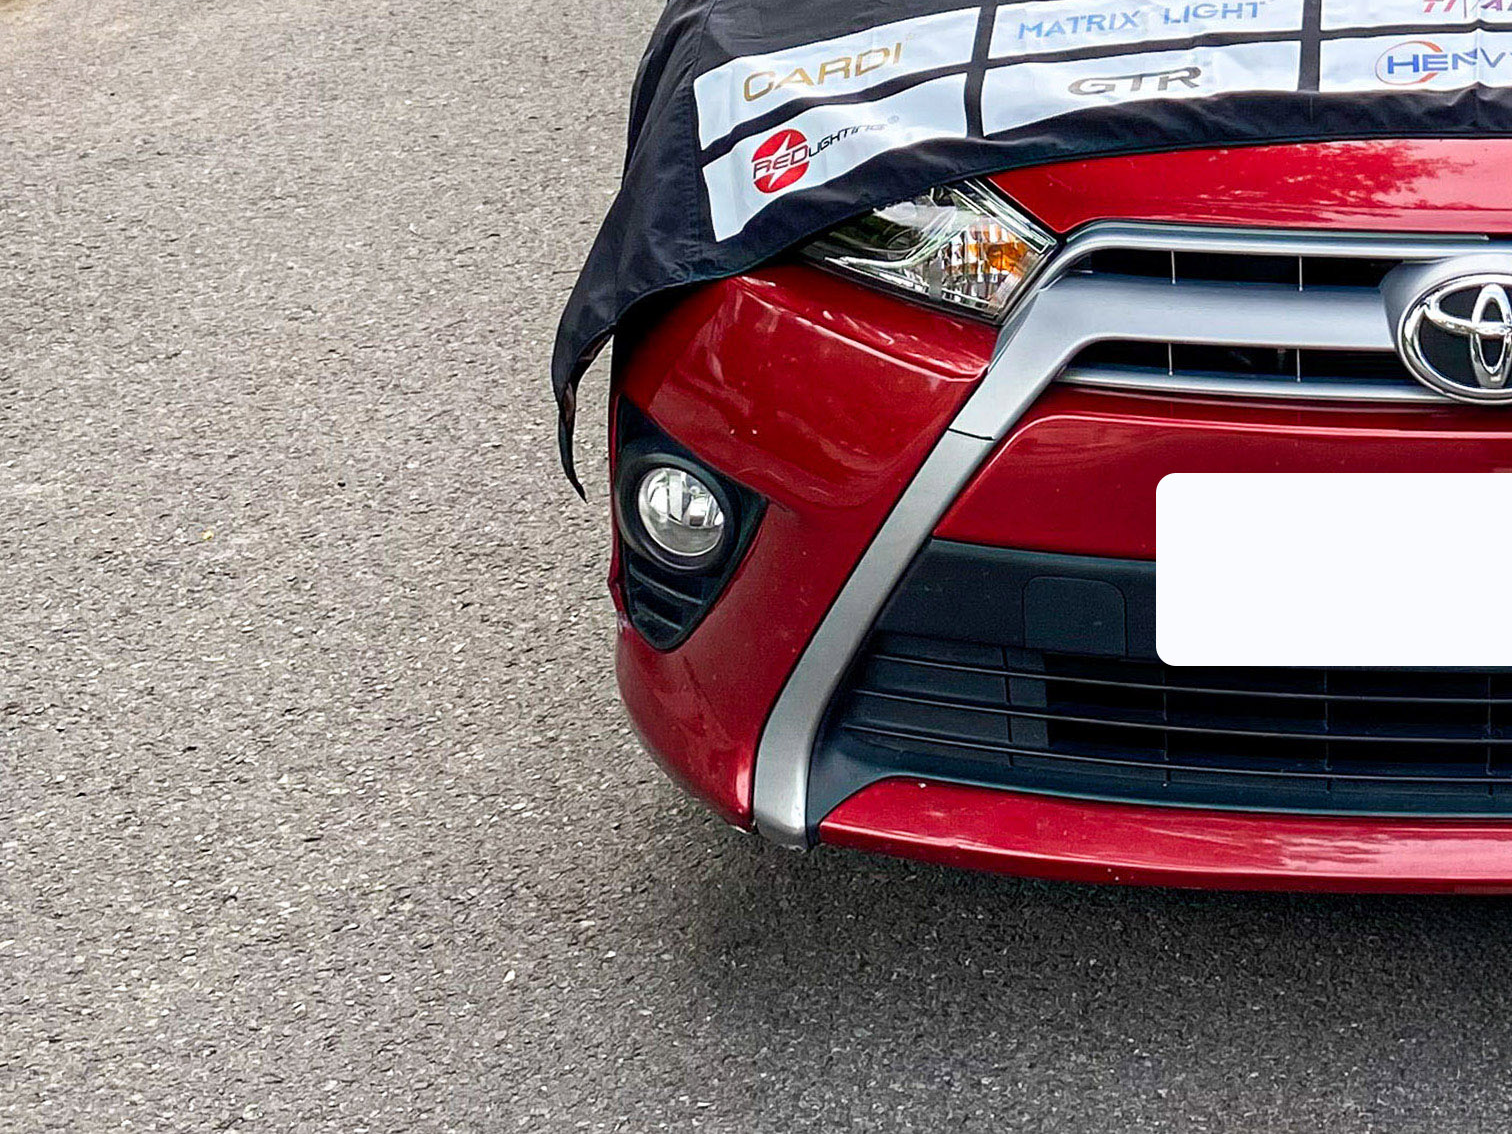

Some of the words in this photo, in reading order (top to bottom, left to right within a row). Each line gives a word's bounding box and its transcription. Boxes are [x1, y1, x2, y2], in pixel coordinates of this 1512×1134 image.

[1018, 10, 1141, 40] MATRIX
[1163, 1, 1265, 25] LIGHT
[743, 42, 902, 102] CARDI
[1068, 66, 1202, 96] GTR
